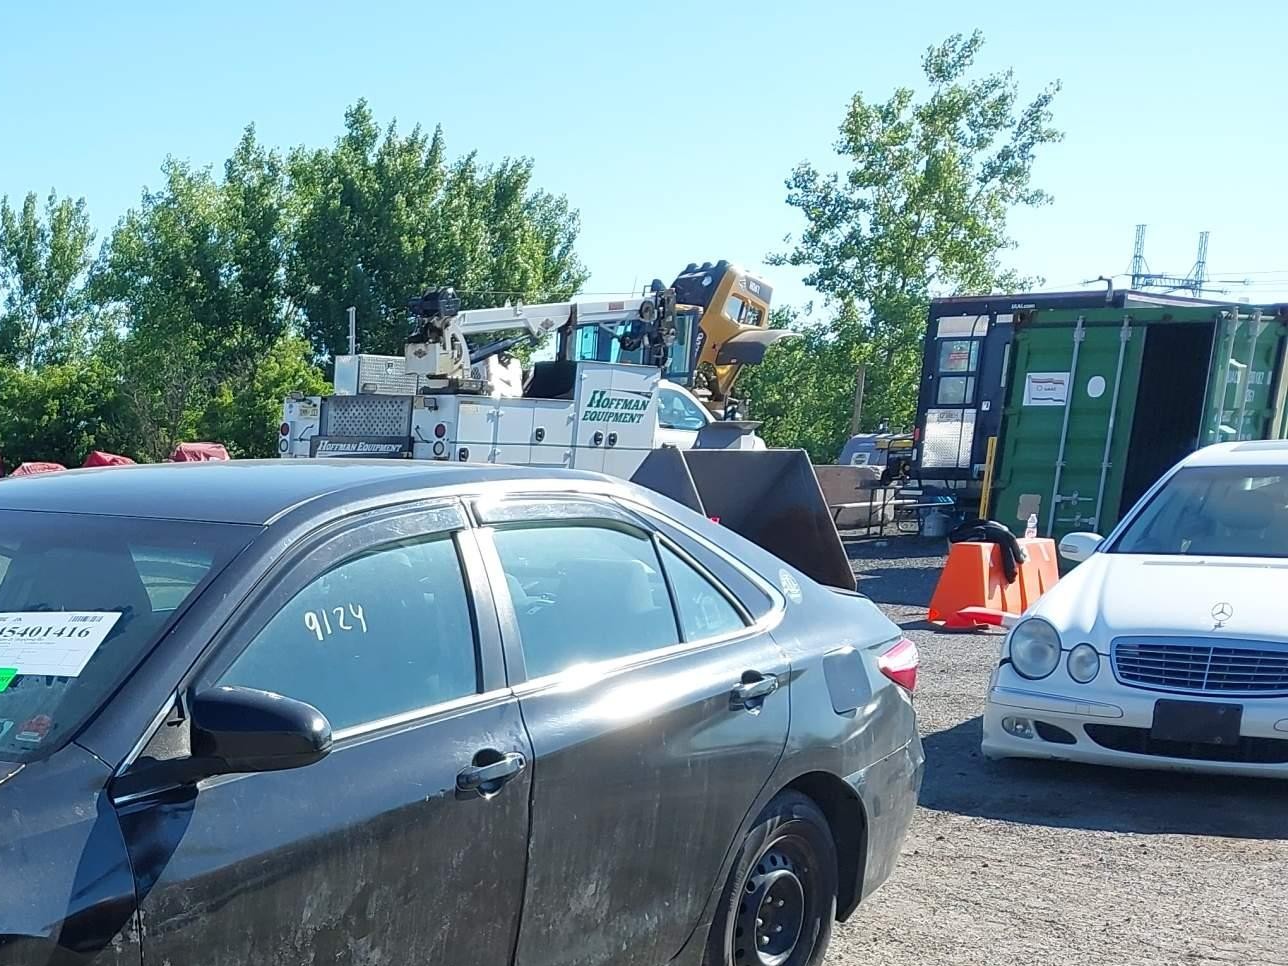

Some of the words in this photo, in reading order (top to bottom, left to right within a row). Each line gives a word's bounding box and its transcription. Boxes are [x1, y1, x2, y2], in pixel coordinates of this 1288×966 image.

[587, 390, 650, 411] HOFFMAN
[582, 411, 644, 424] EQUIPMENT
[317, 440, 357, 451] HOFFMAN
[356, 441, 402, 452] EQUIPMENT
[305, 602, 368, 641] 9124
